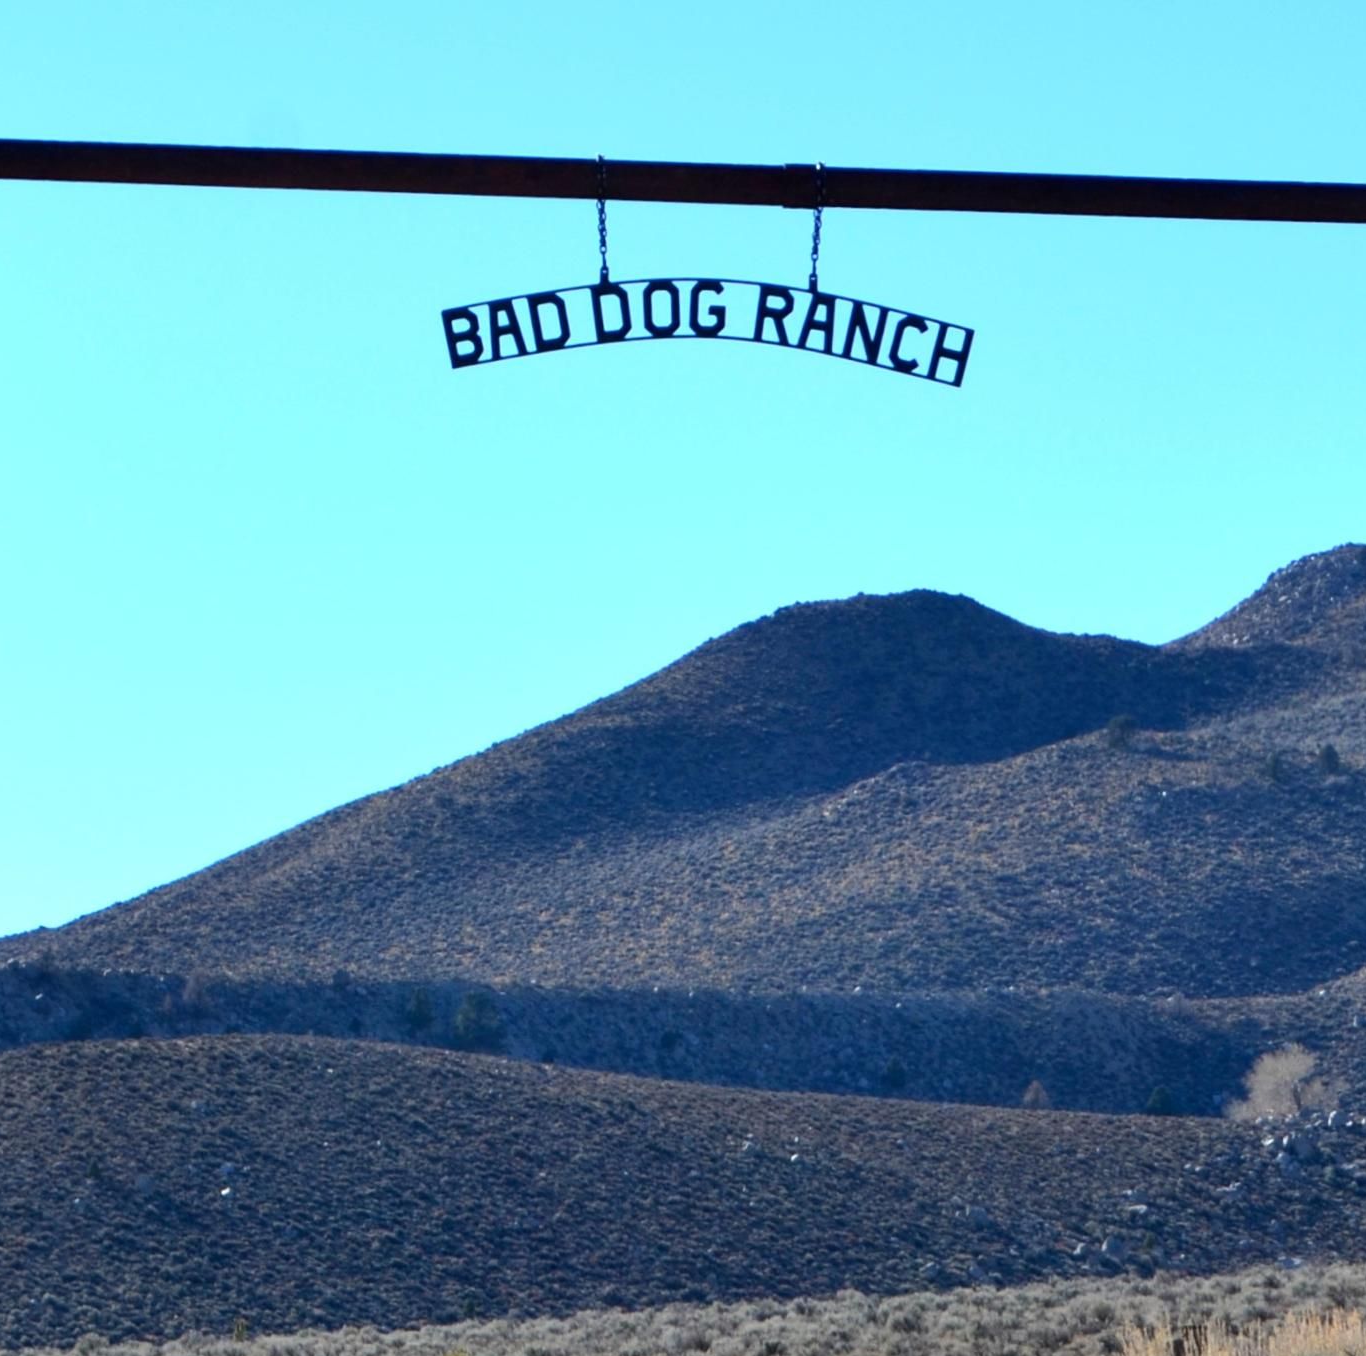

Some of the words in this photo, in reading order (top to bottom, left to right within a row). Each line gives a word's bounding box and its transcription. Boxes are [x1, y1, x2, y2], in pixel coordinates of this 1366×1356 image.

[442, 292, 571, 369] BAD
[591, 280, 727, 345] DOG
[753, 284, 975, 388] RANCH
